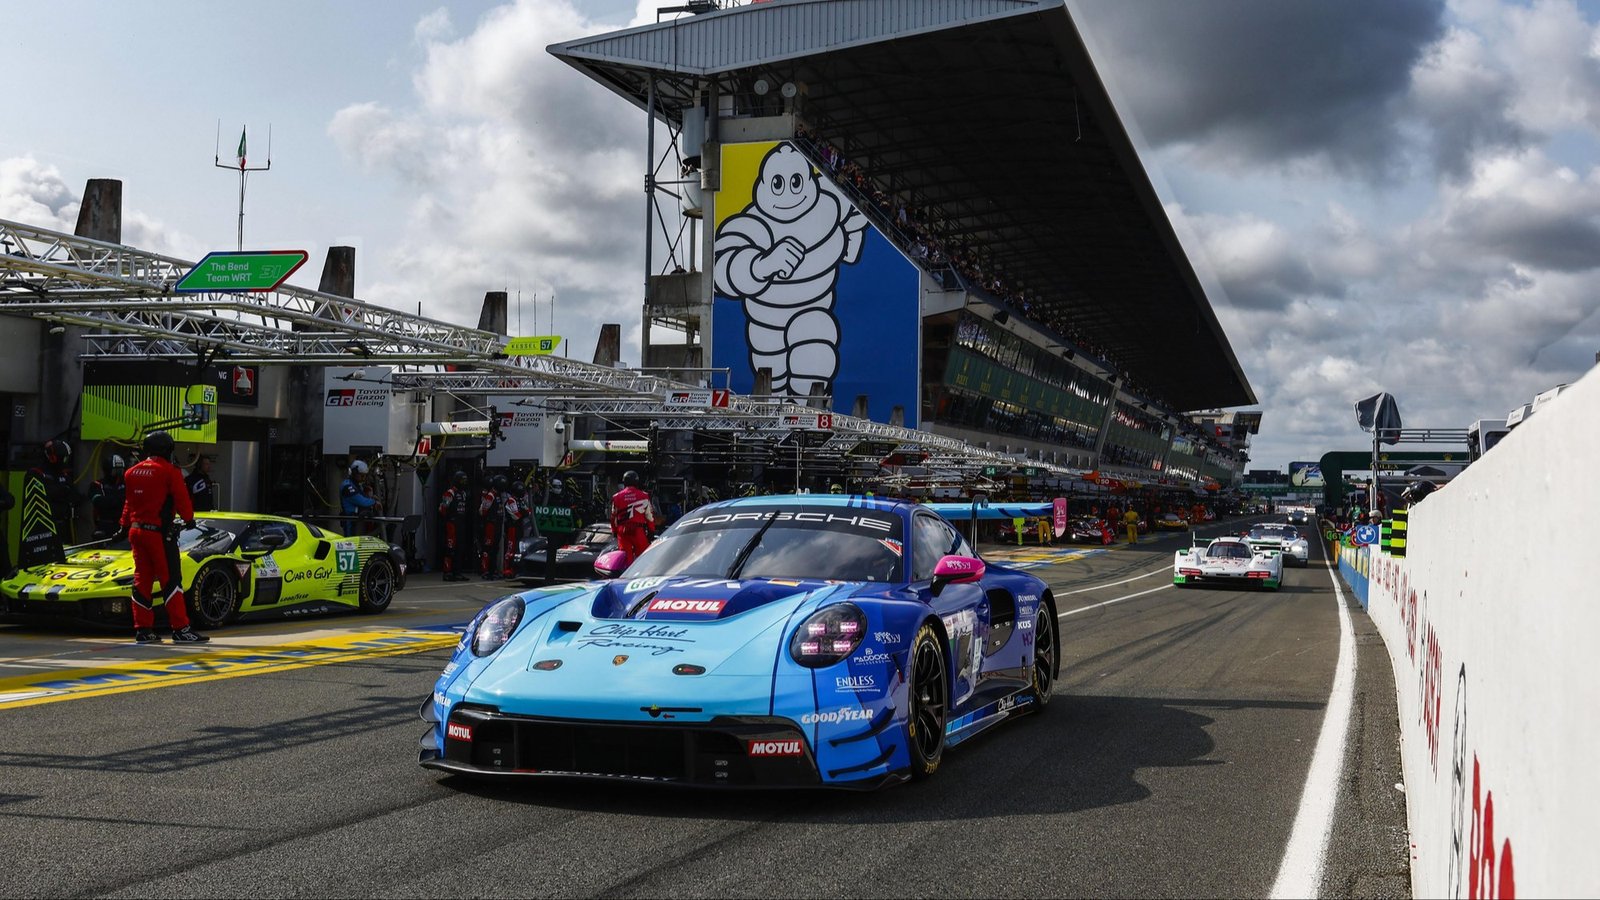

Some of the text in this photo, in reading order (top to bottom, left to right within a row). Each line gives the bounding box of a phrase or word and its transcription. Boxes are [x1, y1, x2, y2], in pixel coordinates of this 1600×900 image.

[211, 262, 249, 271] The Bend
[259, 265, 281, 278] 31
[206, 273, 252, 282] Team WRT
[541, 341, 551, 350] 57
[204, 392, 214, 402] 57
[325, 395, 355, 407] GR
[715, 391, 726, 406] 7
[820, 415, 829, 428] 8
[535, 506, 571, 516] DRV ON
[676, 512, 893, 532] PORSCHE
[339, 552, 355, 572] 57
[314, 567, 333, 580] GUY
[651, 600, 720, 611] MOTUL
[590, 624, 688, 639] Chip Hart
[578, 639, 685, 656] Racing
[853, 653, 889, 663] PADDOCK
[835, 675, 874, 687] ENDLESS
[449, 725, 471, 739] MOTUL
[751, 742, 801, 755] MOTUL
